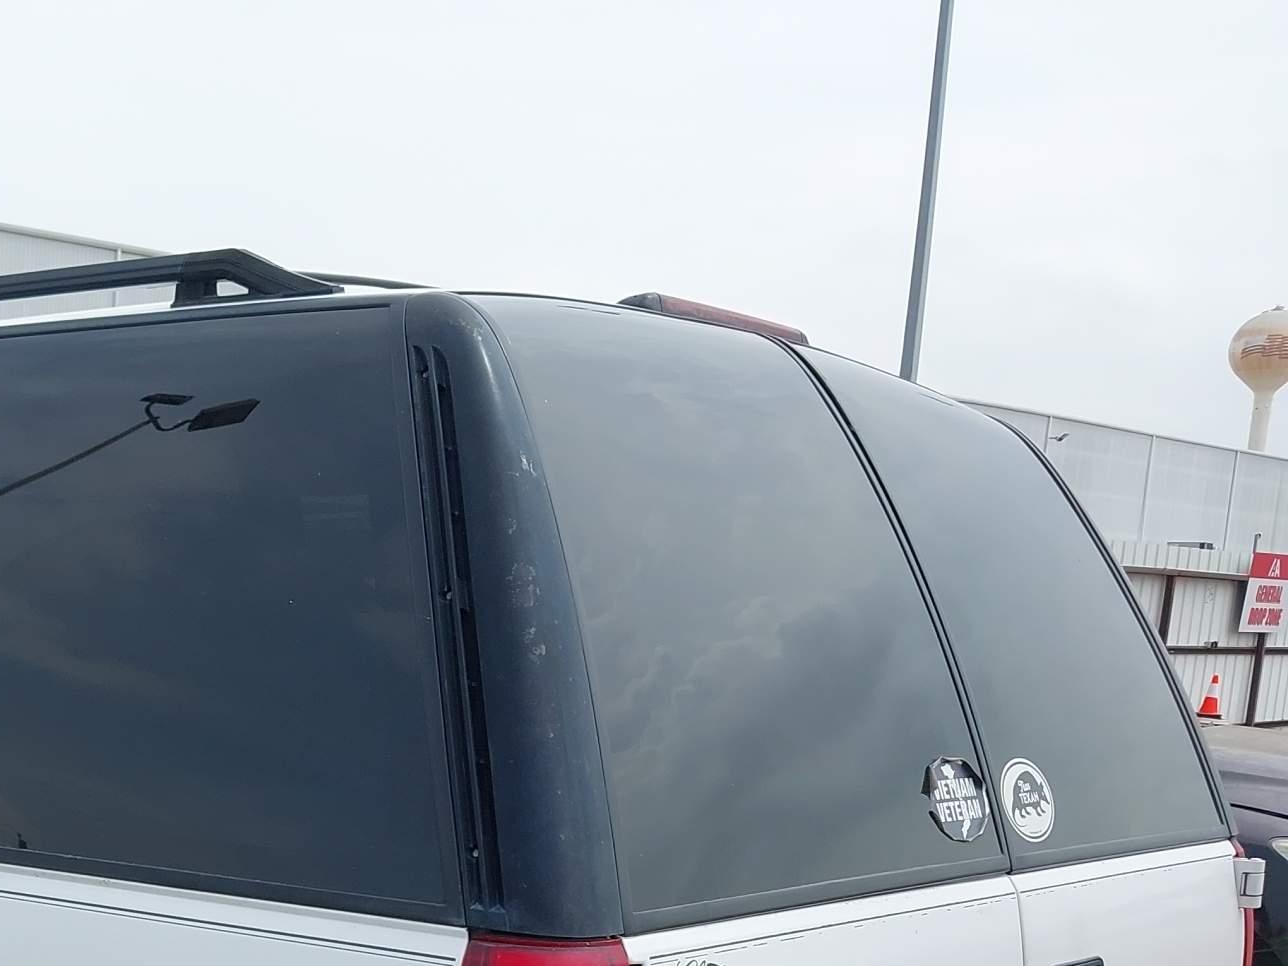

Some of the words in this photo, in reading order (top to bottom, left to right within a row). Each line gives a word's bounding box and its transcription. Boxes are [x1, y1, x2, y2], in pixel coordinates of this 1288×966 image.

[1255, 585, 1283, 604] GENERAL
[1247, 606, 1267, 626] DROP
[1264, 607, 1283, 626] ZONE
[935, 799, 983, 823] VETERAN
